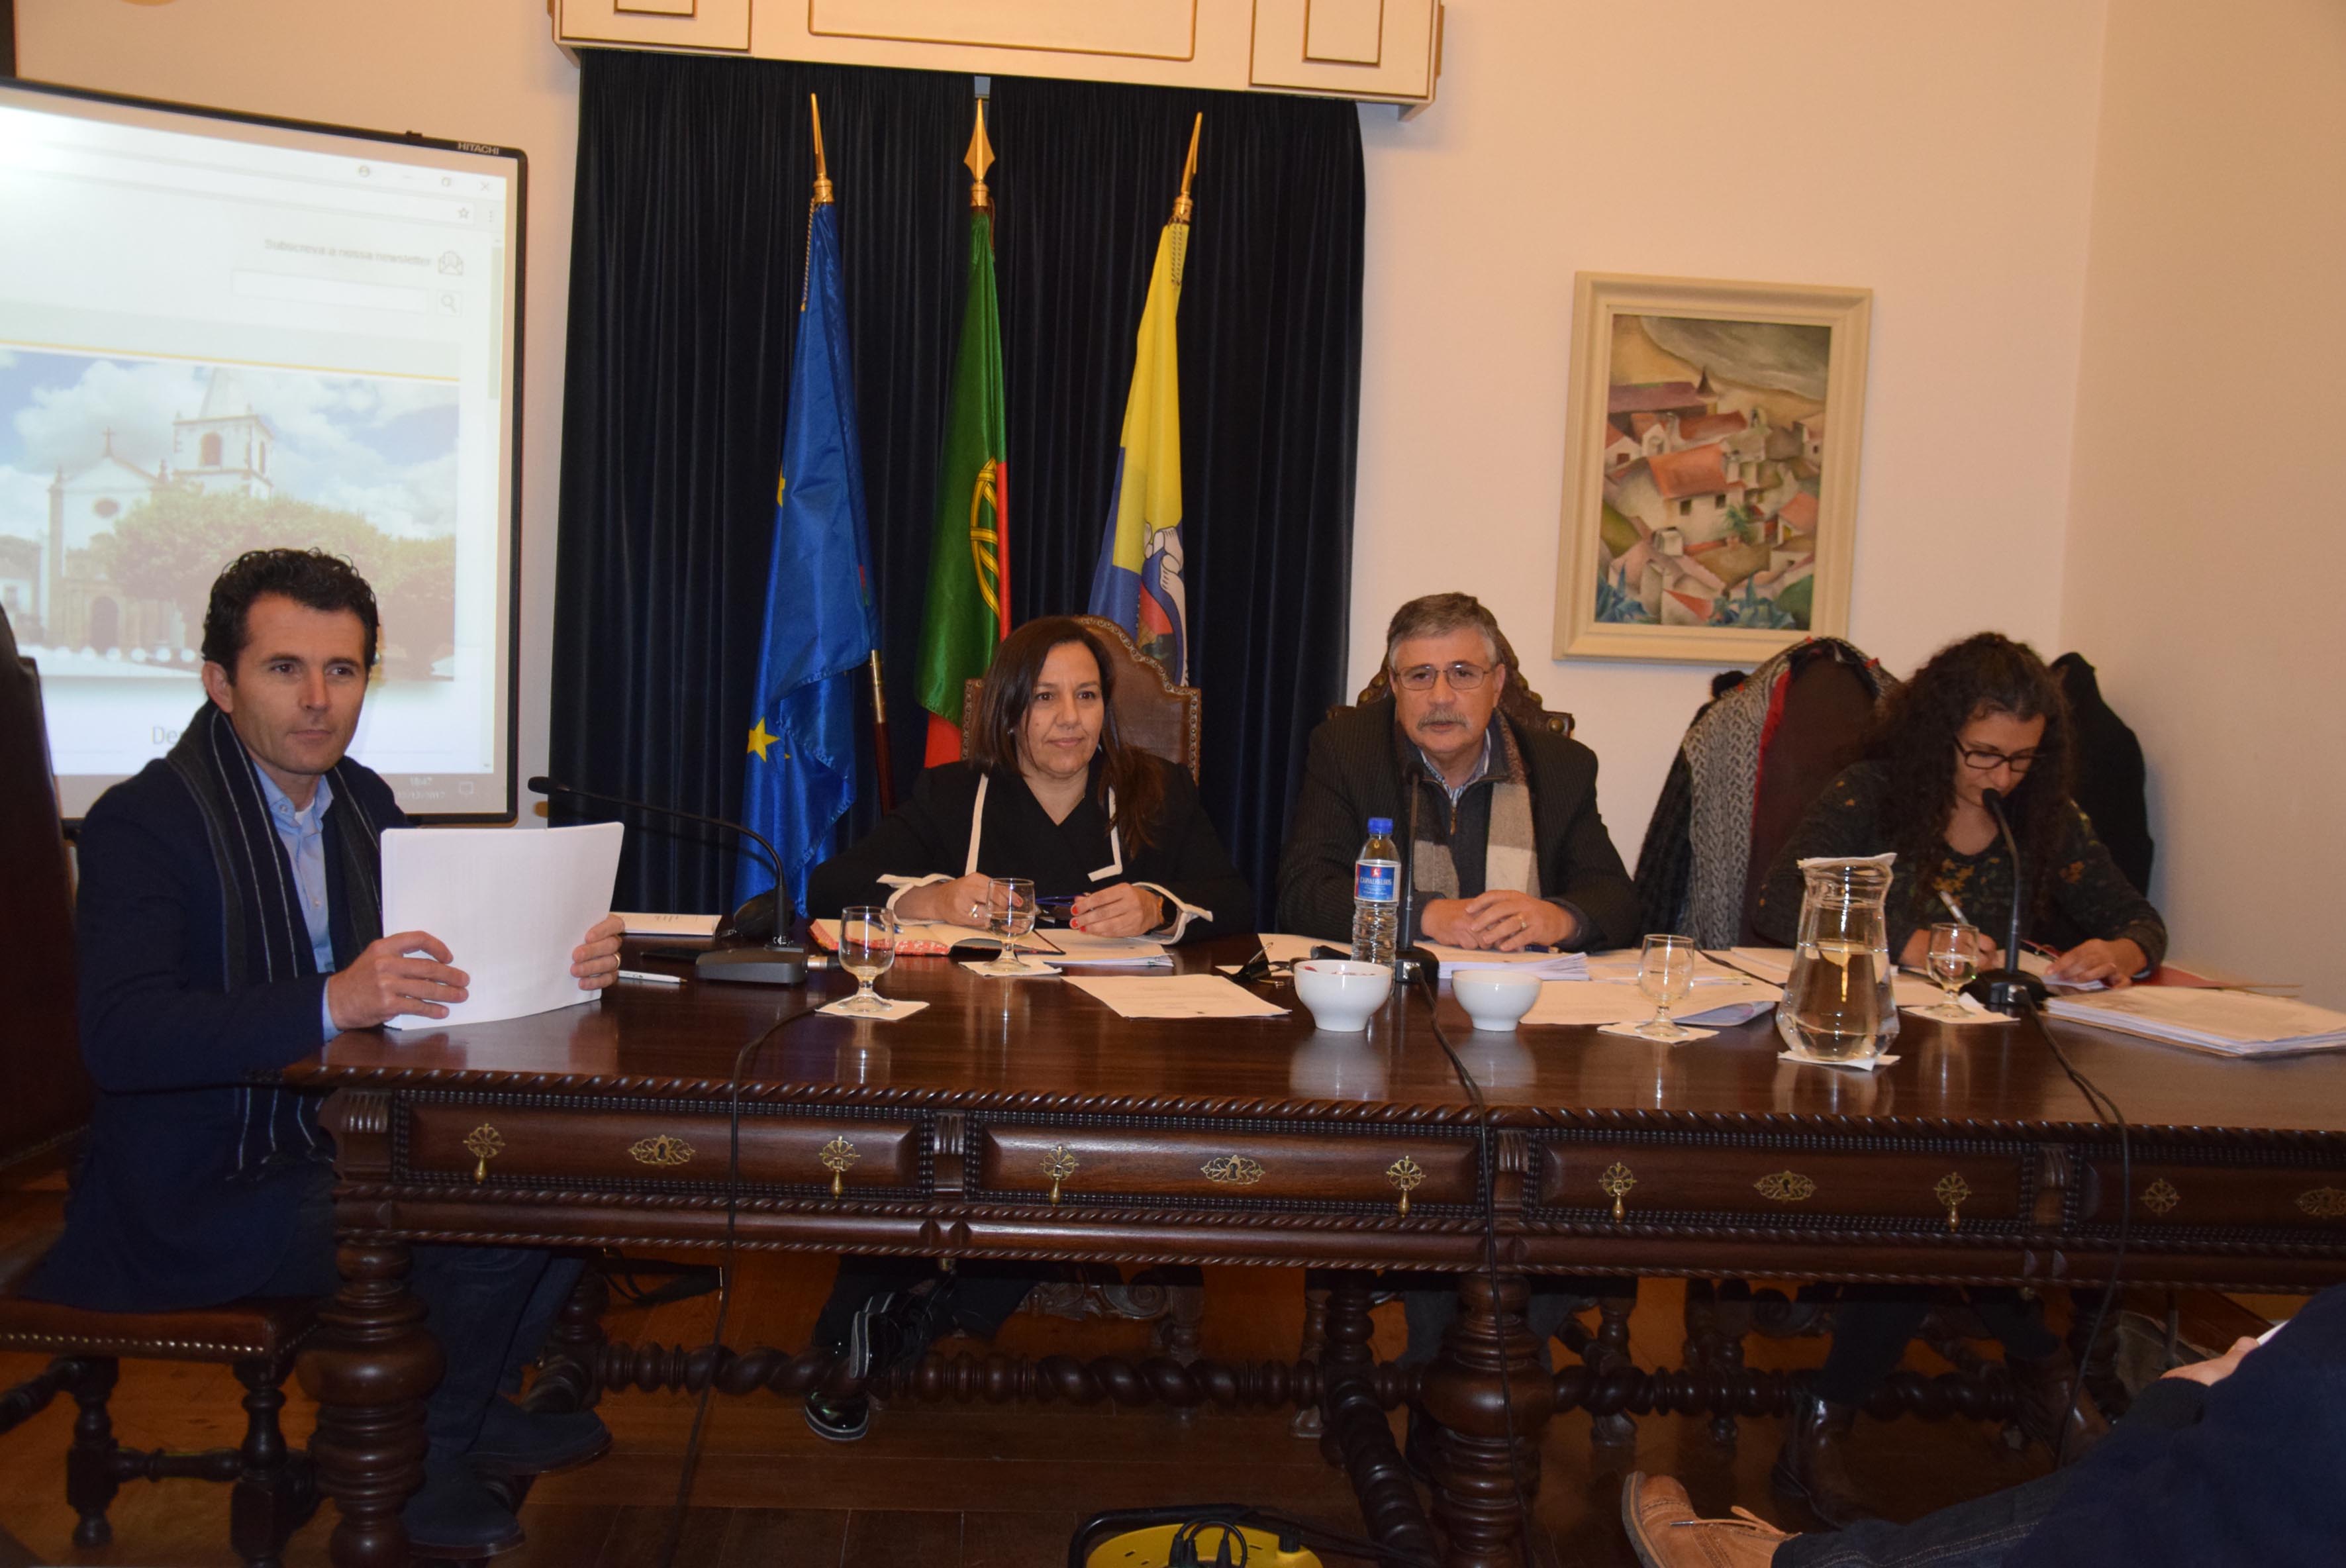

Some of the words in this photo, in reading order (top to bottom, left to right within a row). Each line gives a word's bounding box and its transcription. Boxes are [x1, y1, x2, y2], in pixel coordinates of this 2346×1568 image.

[458, 142, 499, 155] HITACHI
[264, 238, 325, 255] Subscreva
[338, 248, 373, 260] nossa
[375, 253, 432, 266] newsletter
